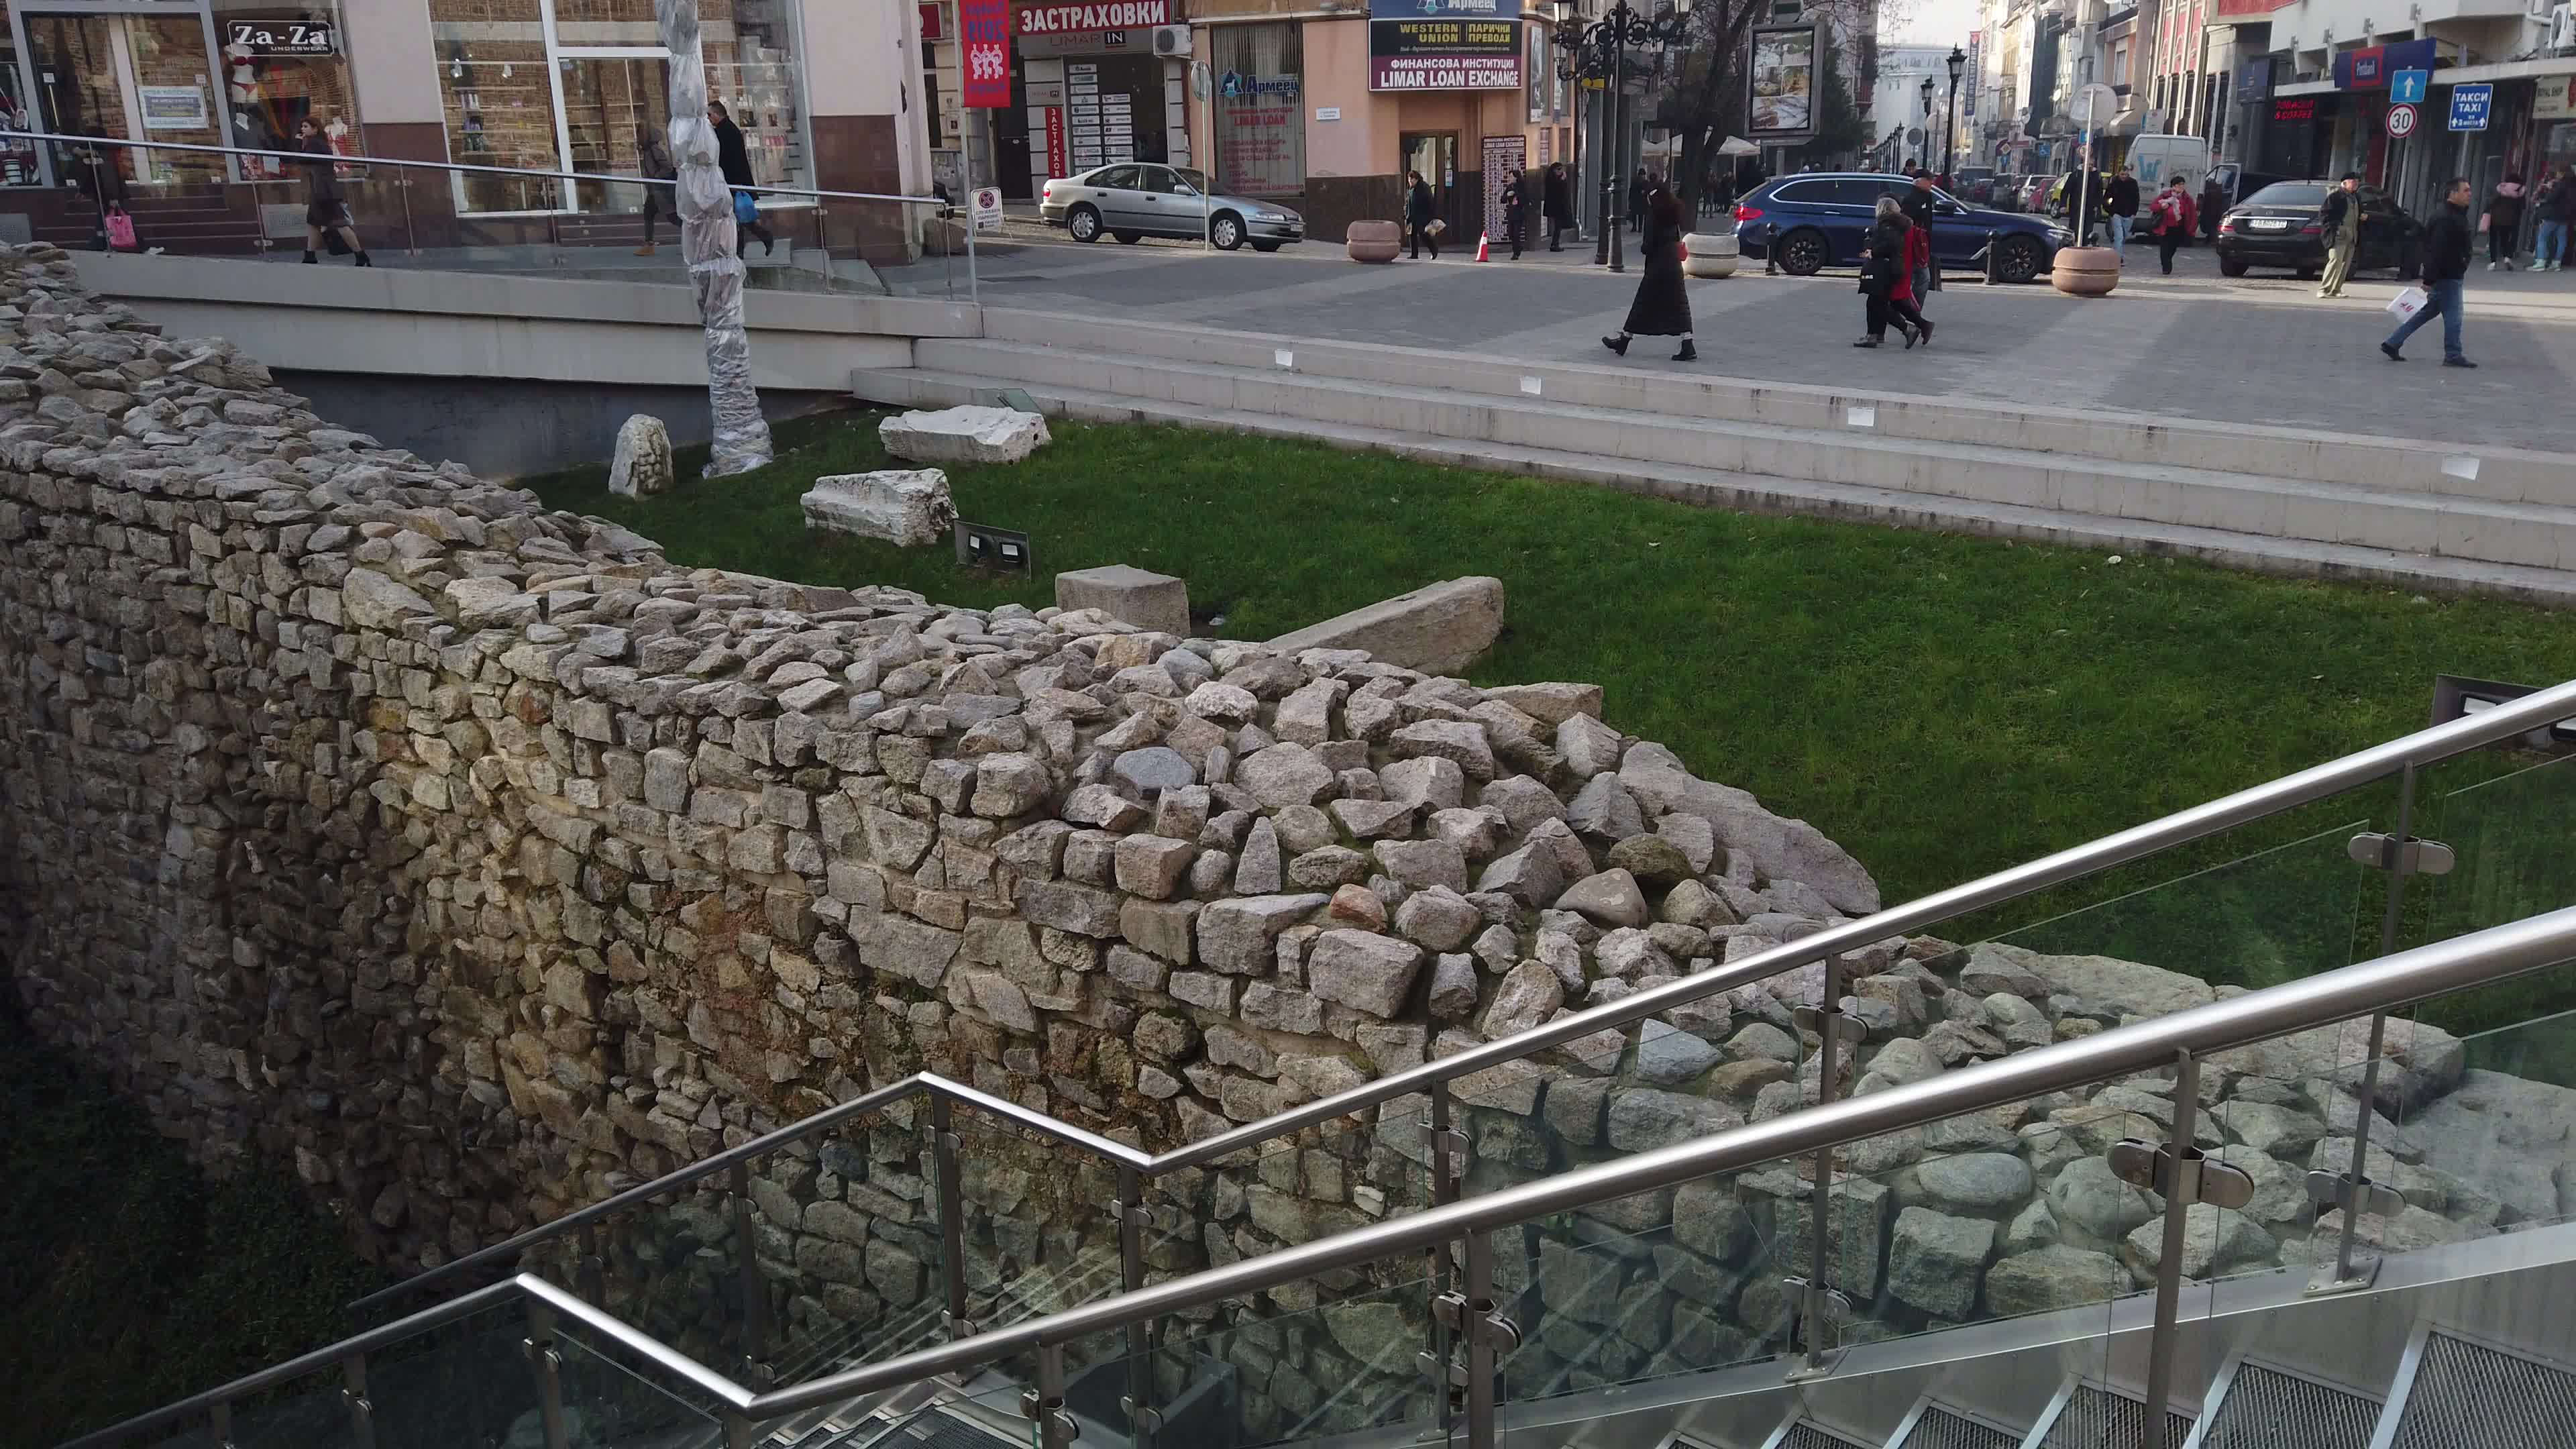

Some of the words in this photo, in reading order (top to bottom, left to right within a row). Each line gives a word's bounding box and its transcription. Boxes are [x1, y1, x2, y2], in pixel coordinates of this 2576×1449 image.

[1021, 1, 1165, 32] ЗАСТРАХОВКИ
[1400, 23, 1459, 33] WESTERN
[1468, 23, 1511, 33] ПАРИЧНИ
[1107, 32, 1124, 44] IN
[1419, 34, 1458, 42] UNION
[1468, 34, 1511, 43] ПРЕВОДИ
[1391, 59, 1460, 69] ФИНАНСОВА
[1462, 59, 1514, 70] ИНСТИТУЦИЯ
[1381, 71, 1427, 87] LIMAR
[1430, 70, 1465, 87] LOAN
[1468, 70, 1518, 87] EXCHANGE
[1245, 75, 1299, 94] Армеец
[2455, 93, 2488, 102] ТАКСИ
[2459, 103, 2481, 112] TAXI
[2393, 113, 2410, 129] 30
